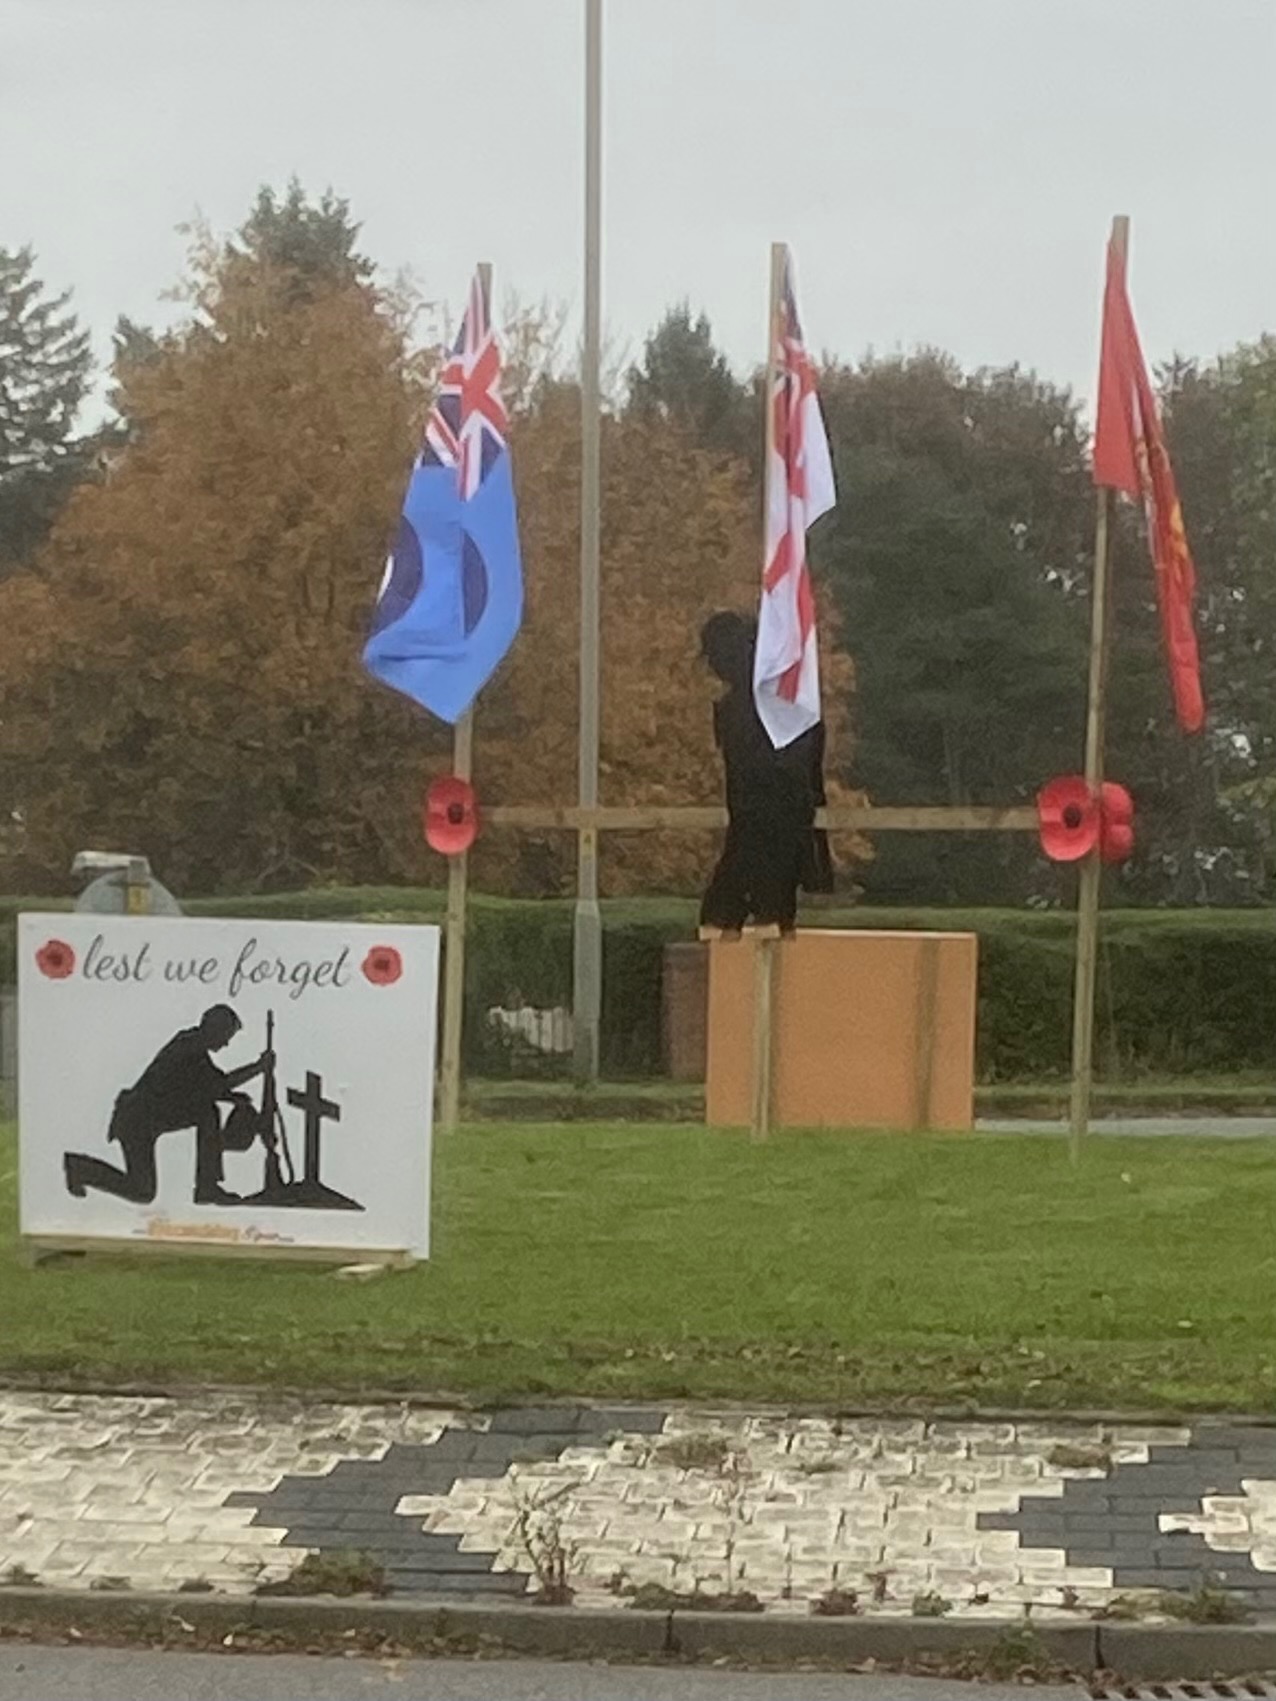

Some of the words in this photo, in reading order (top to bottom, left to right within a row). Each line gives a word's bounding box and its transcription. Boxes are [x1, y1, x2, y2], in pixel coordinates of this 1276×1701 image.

[82, 934, 150, 982] lest
[164, 957, 219, 982] we
[229, 938, 350, 999] forget
